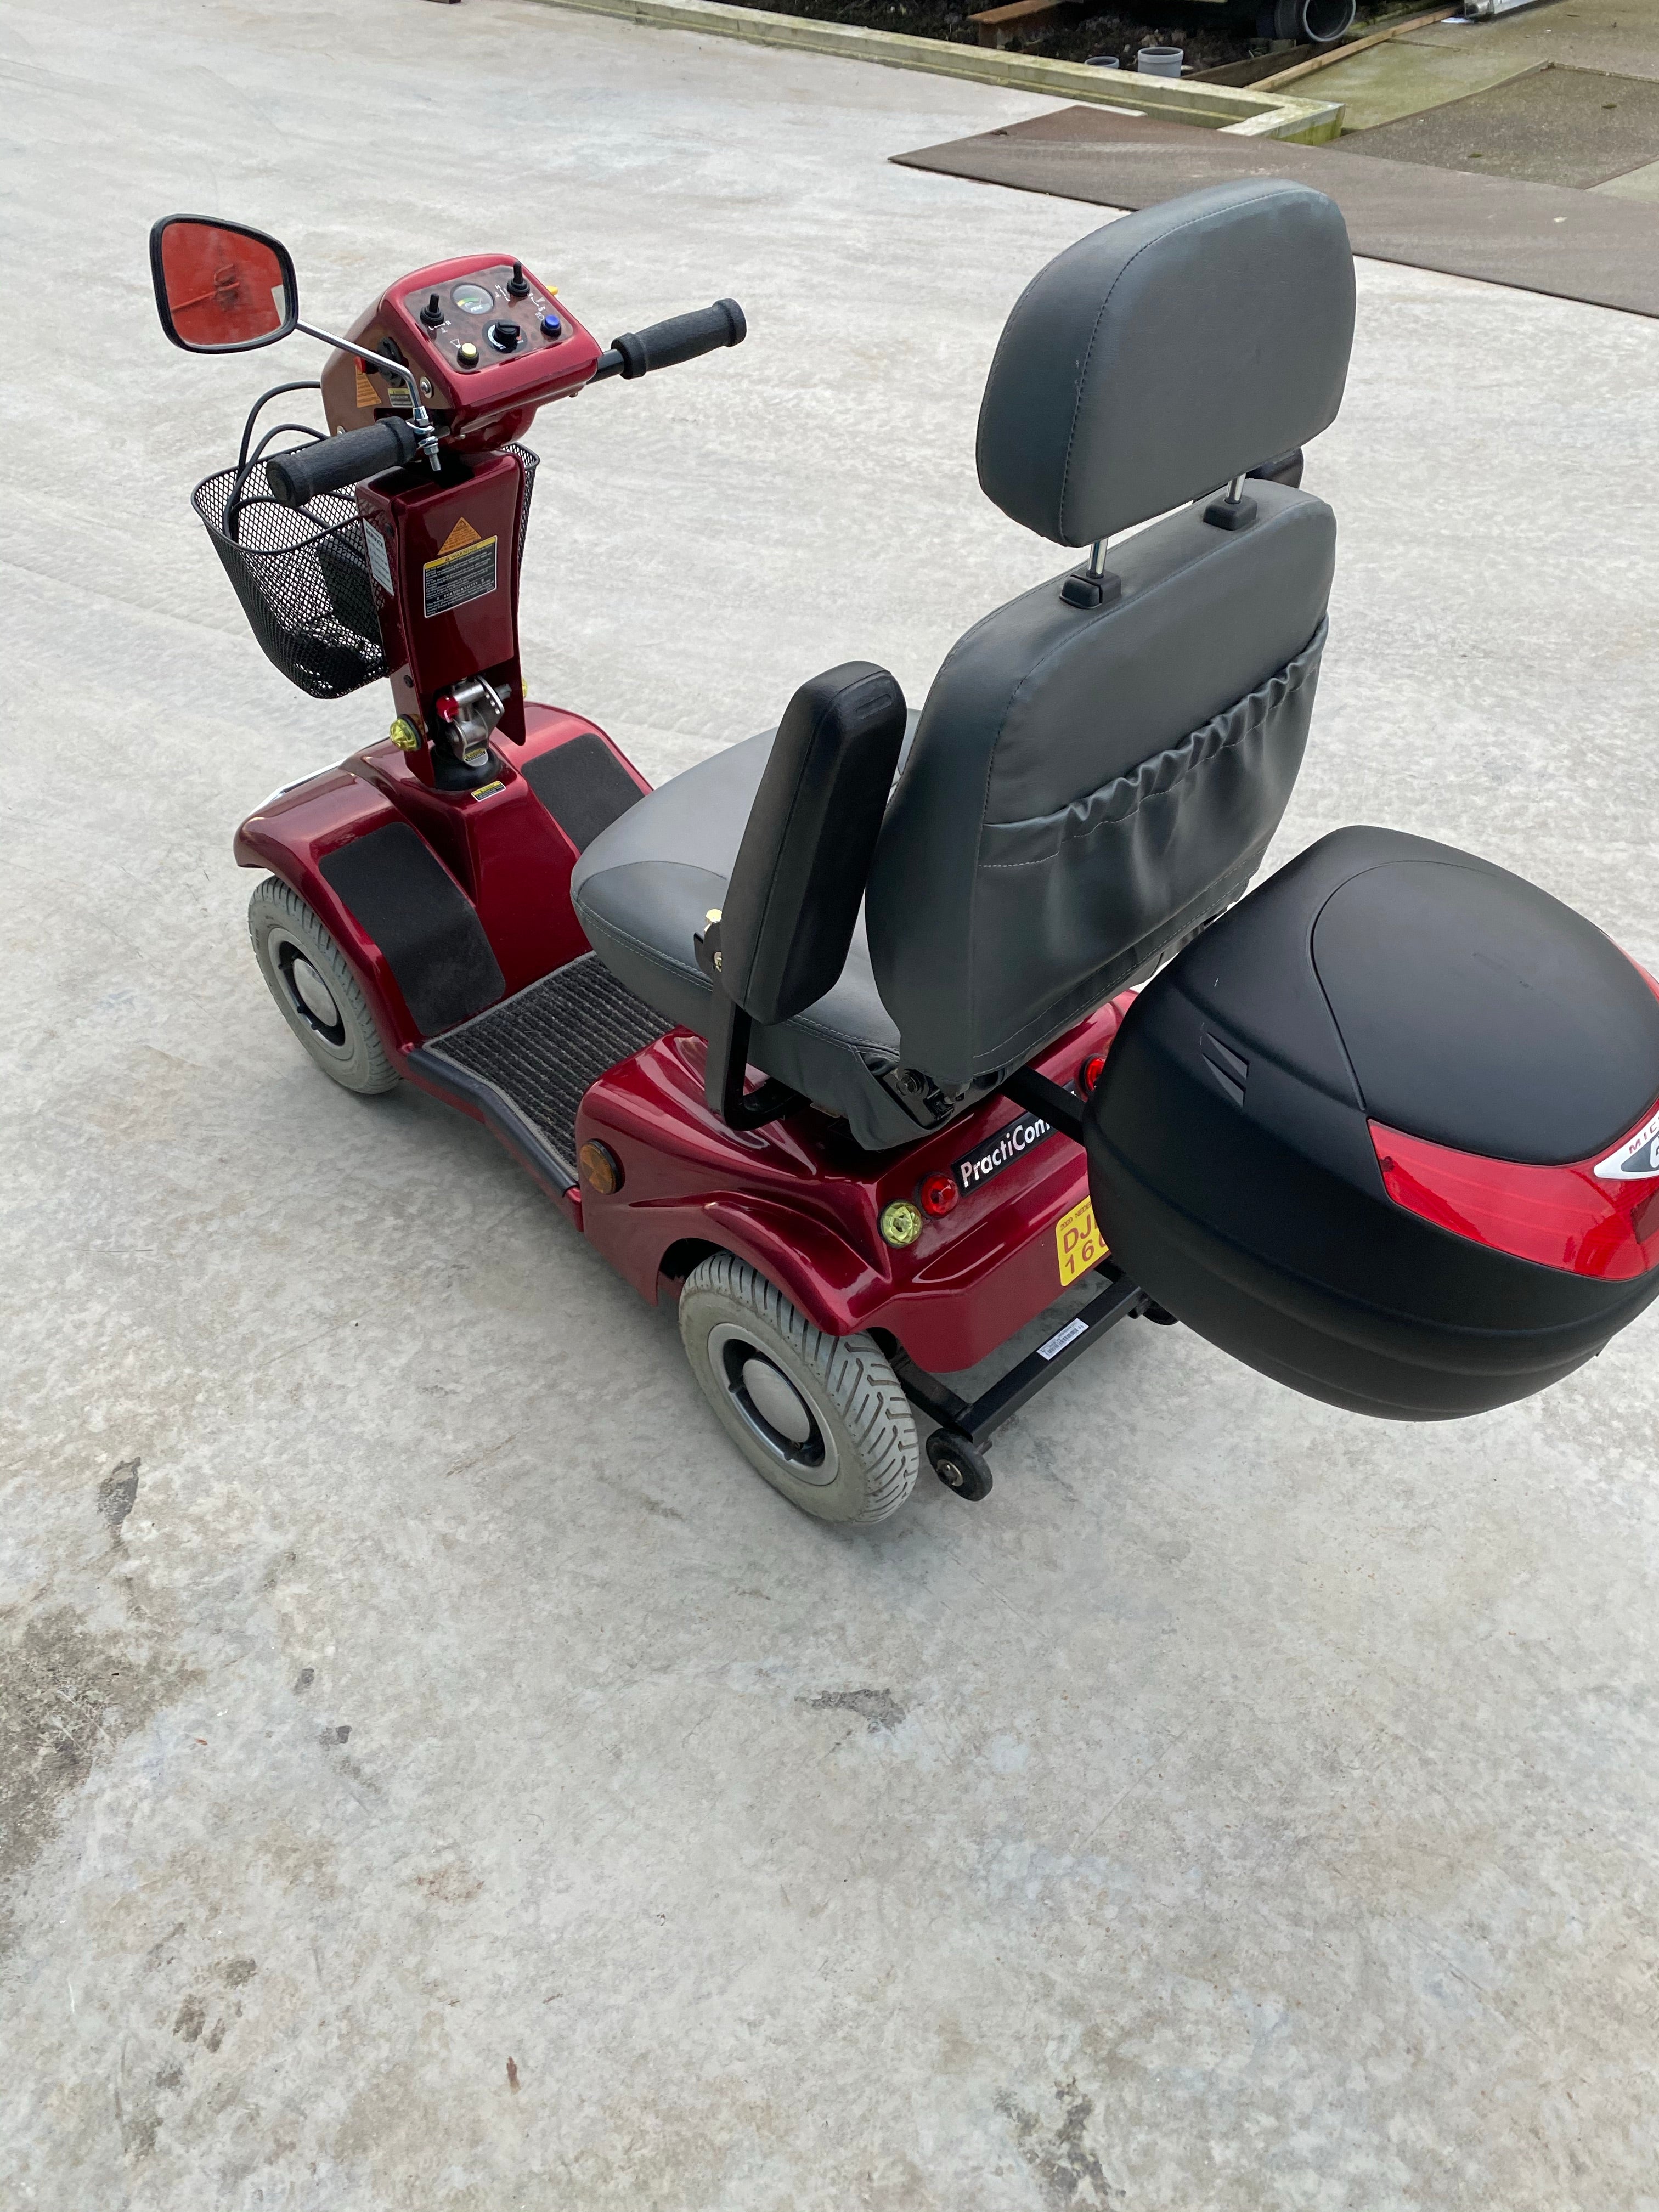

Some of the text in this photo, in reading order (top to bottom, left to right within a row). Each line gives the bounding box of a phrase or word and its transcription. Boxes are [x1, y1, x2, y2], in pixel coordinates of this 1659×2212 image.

[451, 545, 477, 558] WARNING
[960, 1118, 1051, 1188] PractiCom
[1629, 1116, 1659, 1154] MIC
[1060, 1217, 1073, 1231] 2020
[1063, 1214, 1099, 1254] DJ
